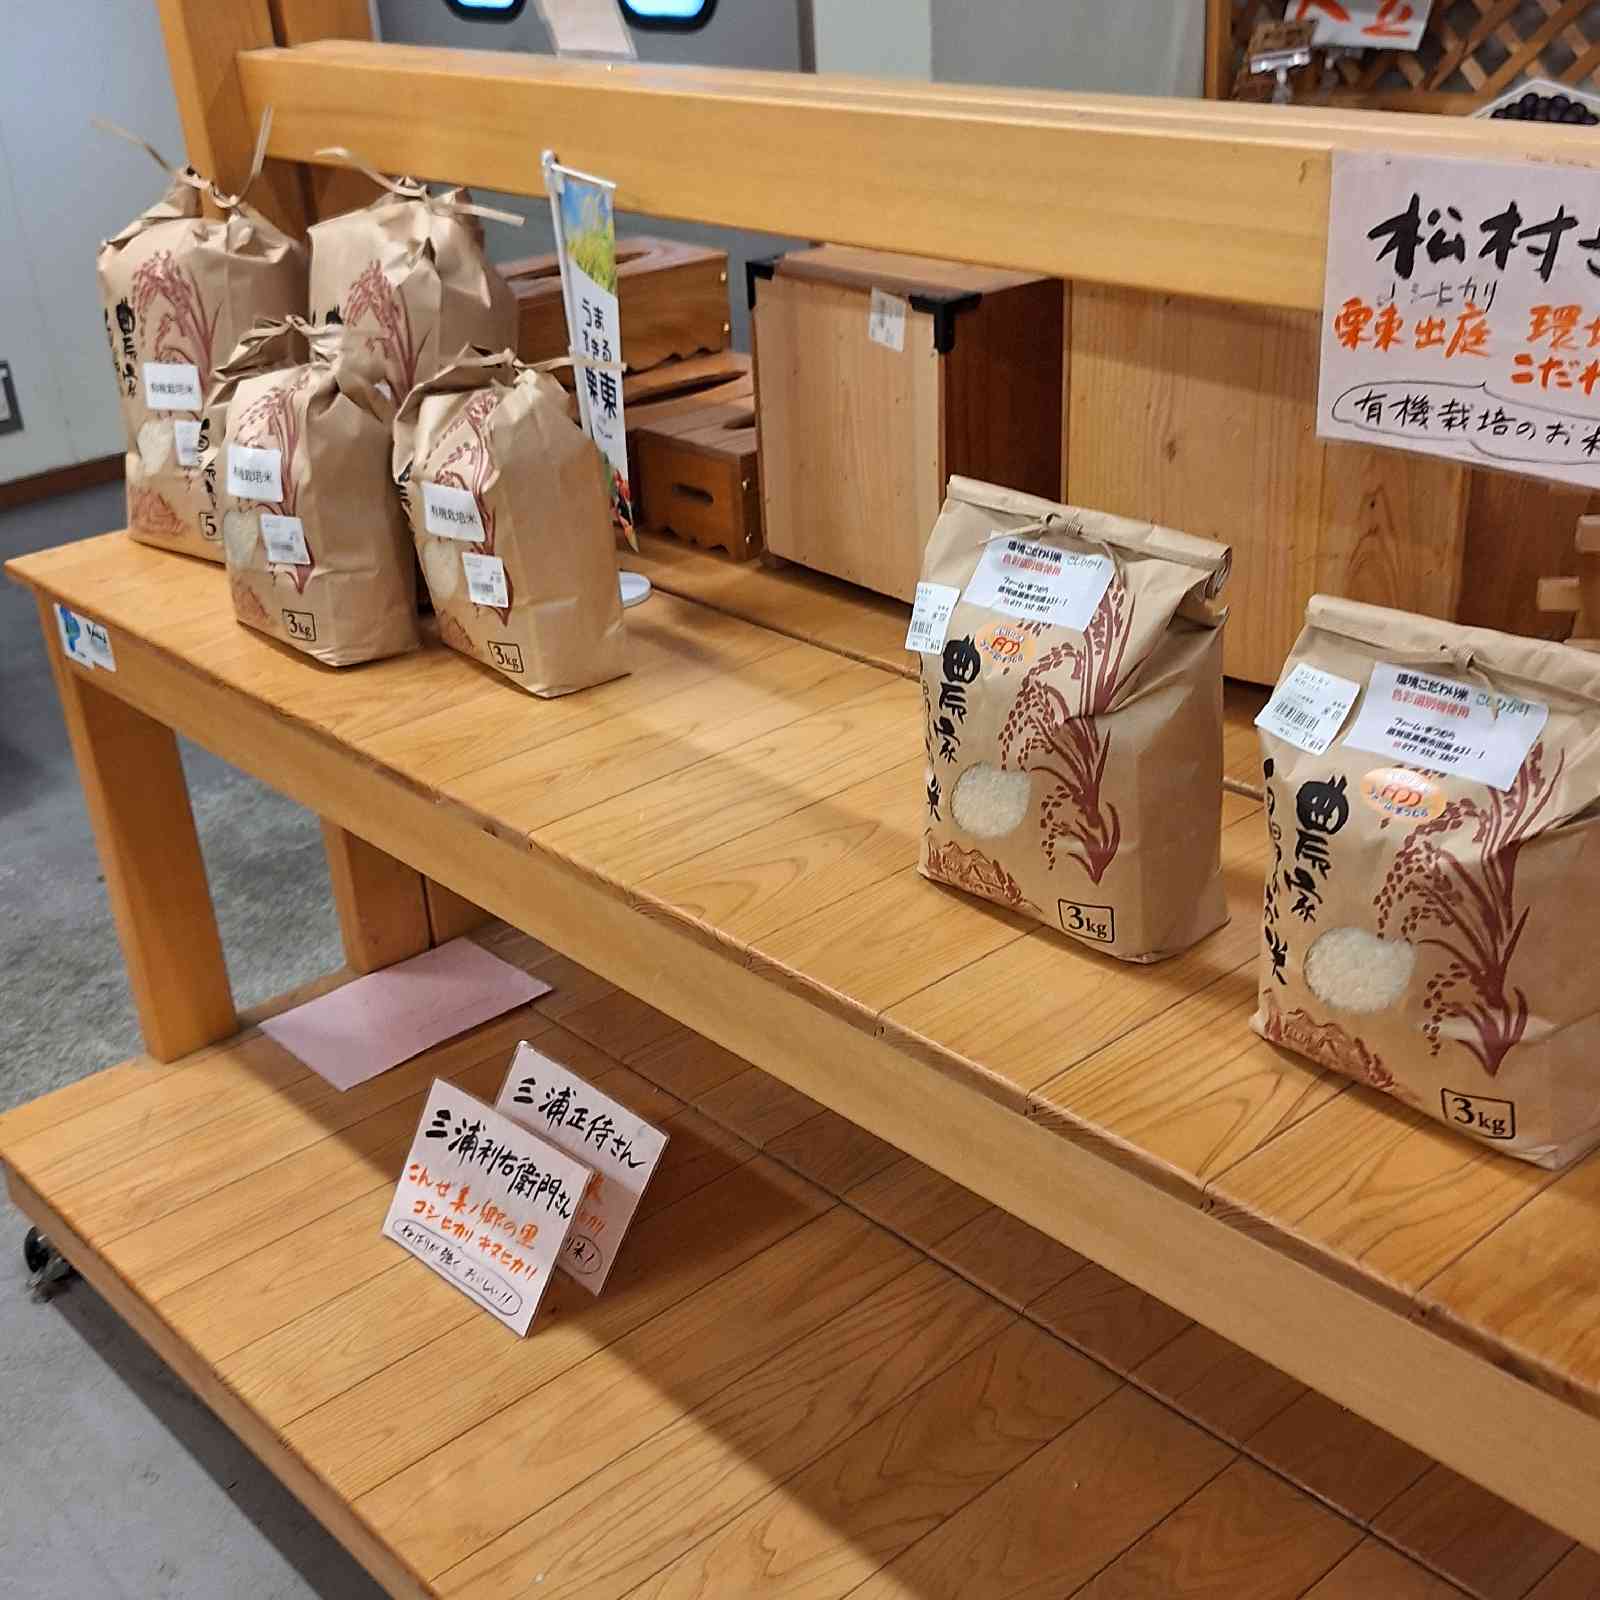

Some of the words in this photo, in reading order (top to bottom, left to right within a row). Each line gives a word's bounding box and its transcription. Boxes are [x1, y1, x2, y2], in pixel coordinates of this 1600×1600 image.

[494, 645, 520, 670] 3kg
[1396, 673, 1470, 700] 環境こだわり米
[1067, 905, 1108, 938] 3kg
[1453, 1097, 1506, 1135] 3kg
[413, 1200, 474, 1243] コシヒカリ
